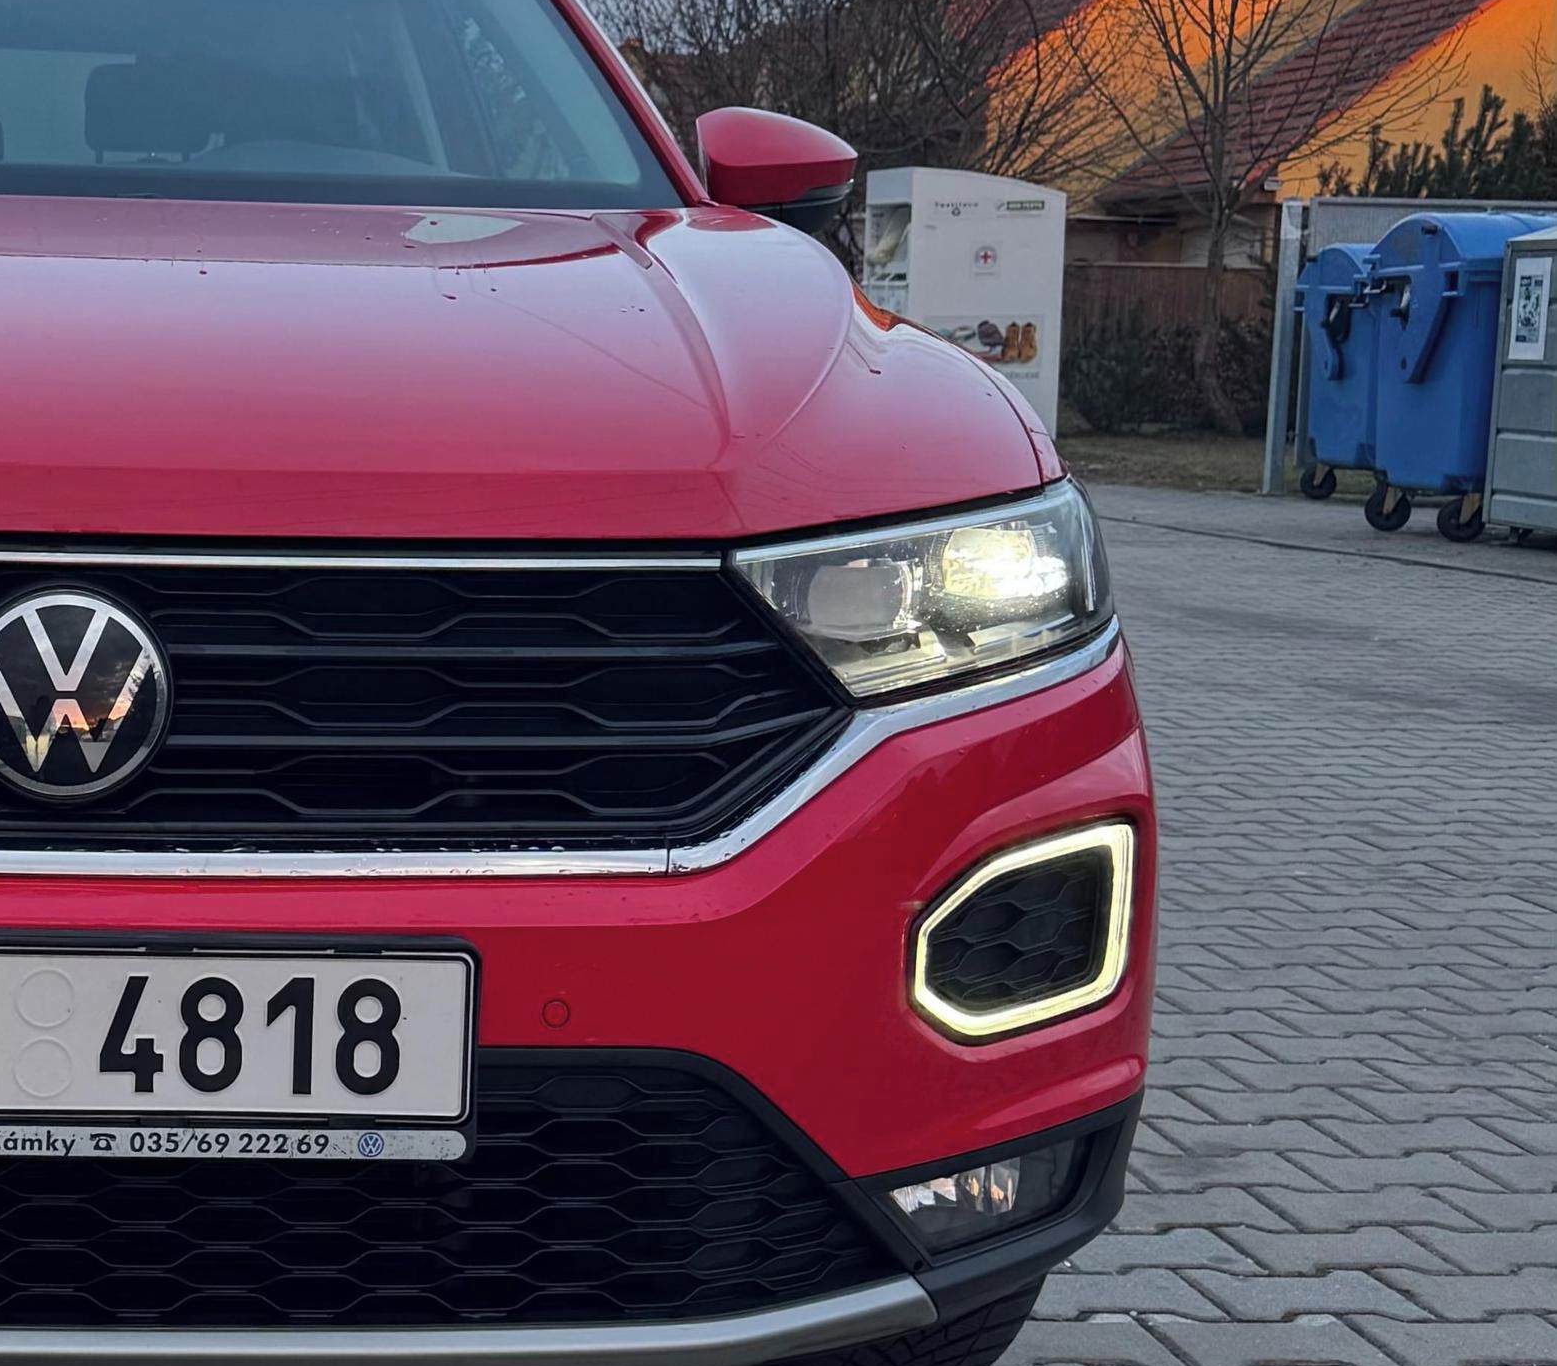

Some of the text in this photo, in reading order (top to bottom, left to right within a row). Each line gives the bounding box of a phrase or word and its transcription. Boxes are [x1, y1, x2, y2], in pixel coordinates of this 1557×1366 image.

[100, 976, 401, 1095] 4818
[130, 1130, 230, 1153] 035/69
[238, 1133, 288, 1153] 222
[296, 1133, 329, 1153] 69
